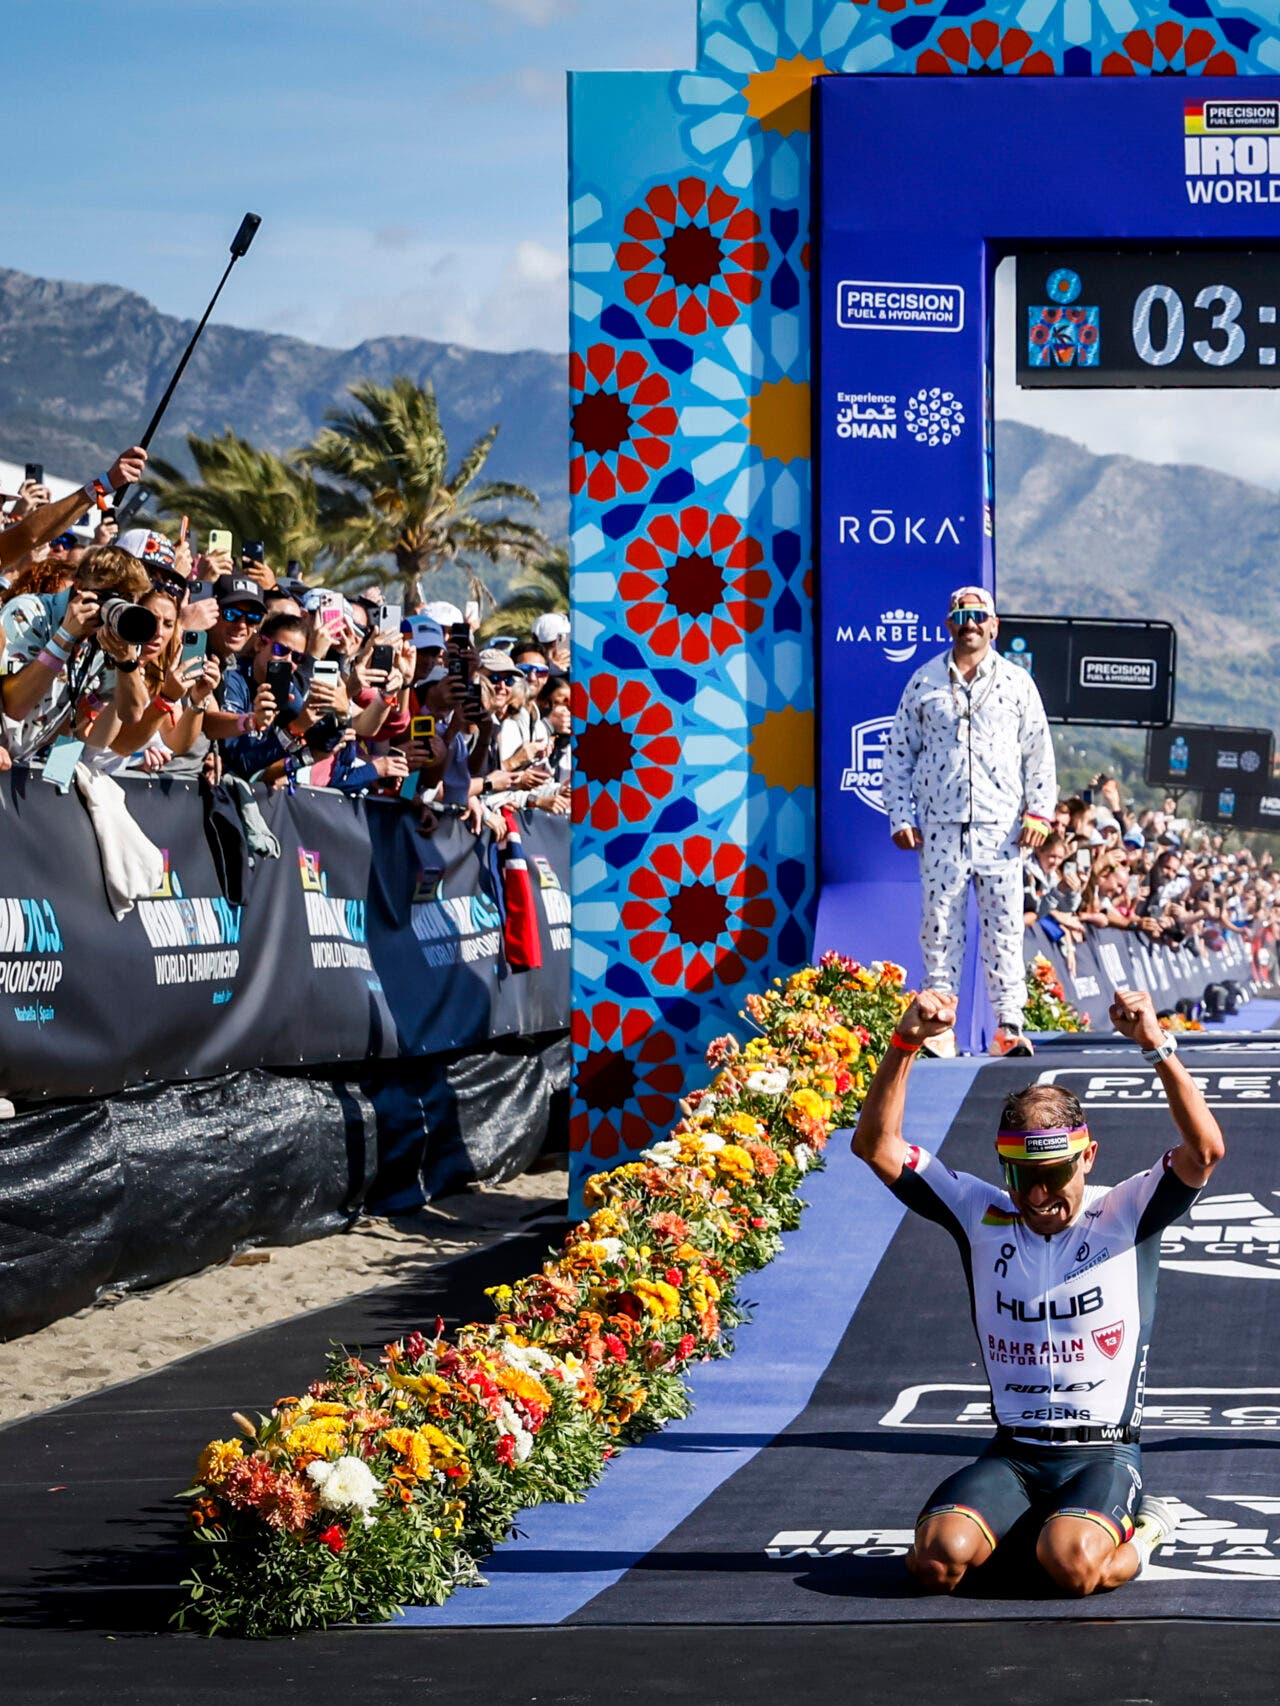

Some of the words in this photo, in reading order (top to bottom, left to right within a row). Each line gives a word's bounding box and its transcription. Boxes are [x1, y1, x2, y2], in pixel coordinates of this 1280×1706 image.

[1210, 108, 1276, 118] PRECISION
[848, 291, 954, 310] PRECISION
[848, 308, 876, 319] FUEL
[878, 309, 887, 320] &
[888, 310, 953, 322] HYDRATION
[837, 392, 896, 404] Experience
[836, 424, 896, 439] OMAN
[836, 626, 954, 642] MARBELL
[1086, 663, 1150, 676] PRECISION
[310, 942, 341, 968] WORLD
[154, 954, 186, 985] WORLD
[1028, 1136, 1067, 1146] PRECISION
[996, 1286, 1104, 1322] HUUB
[988, 1334, 1084, 1354] BAHRAIN
[990, 1352, 1085, 1366] VICTORIOUS
[1004, 1378, 1107, 1394] RIDLEY
